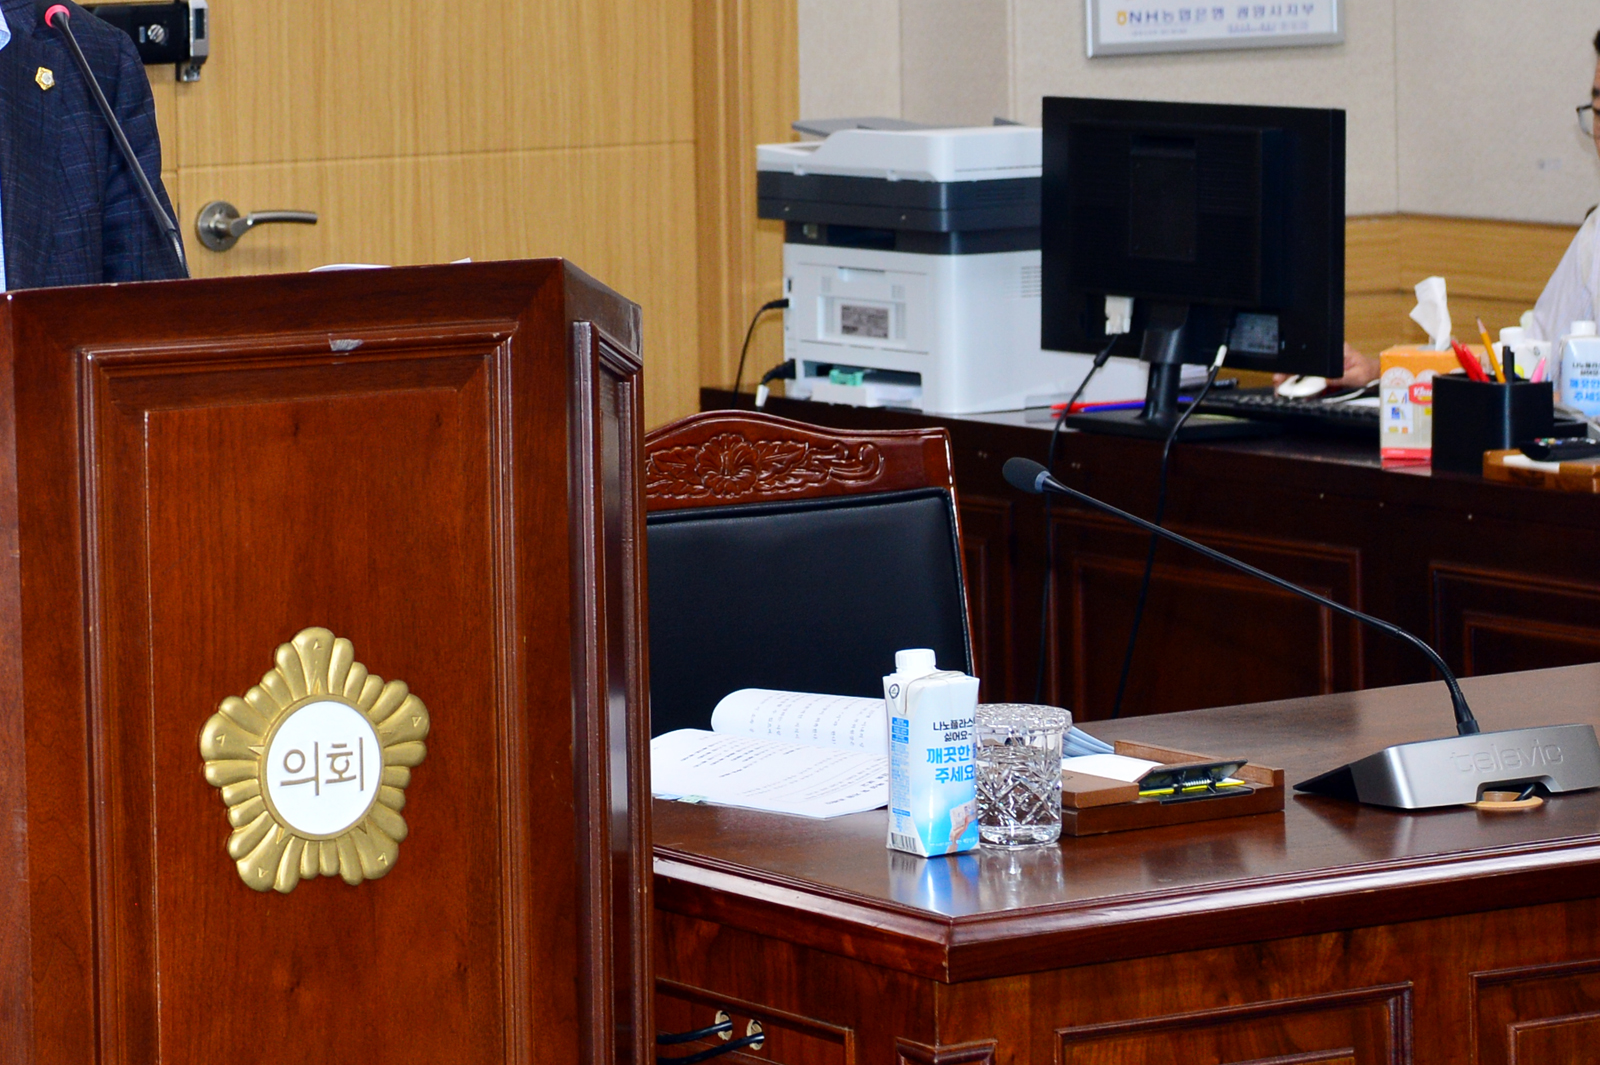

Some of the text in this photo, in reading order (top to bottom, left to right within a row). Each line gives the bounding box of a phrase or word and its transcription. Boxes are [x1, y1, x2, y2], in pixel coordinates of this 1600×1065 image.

[933, 717, 975, 731] 나노플라스
[926, 744, 971, 764] 깨끗한
[1450, 738, 1565, 774] televic
[279, 736, 365, 797] 의회
[935, 764, 976, 784] 주세요
